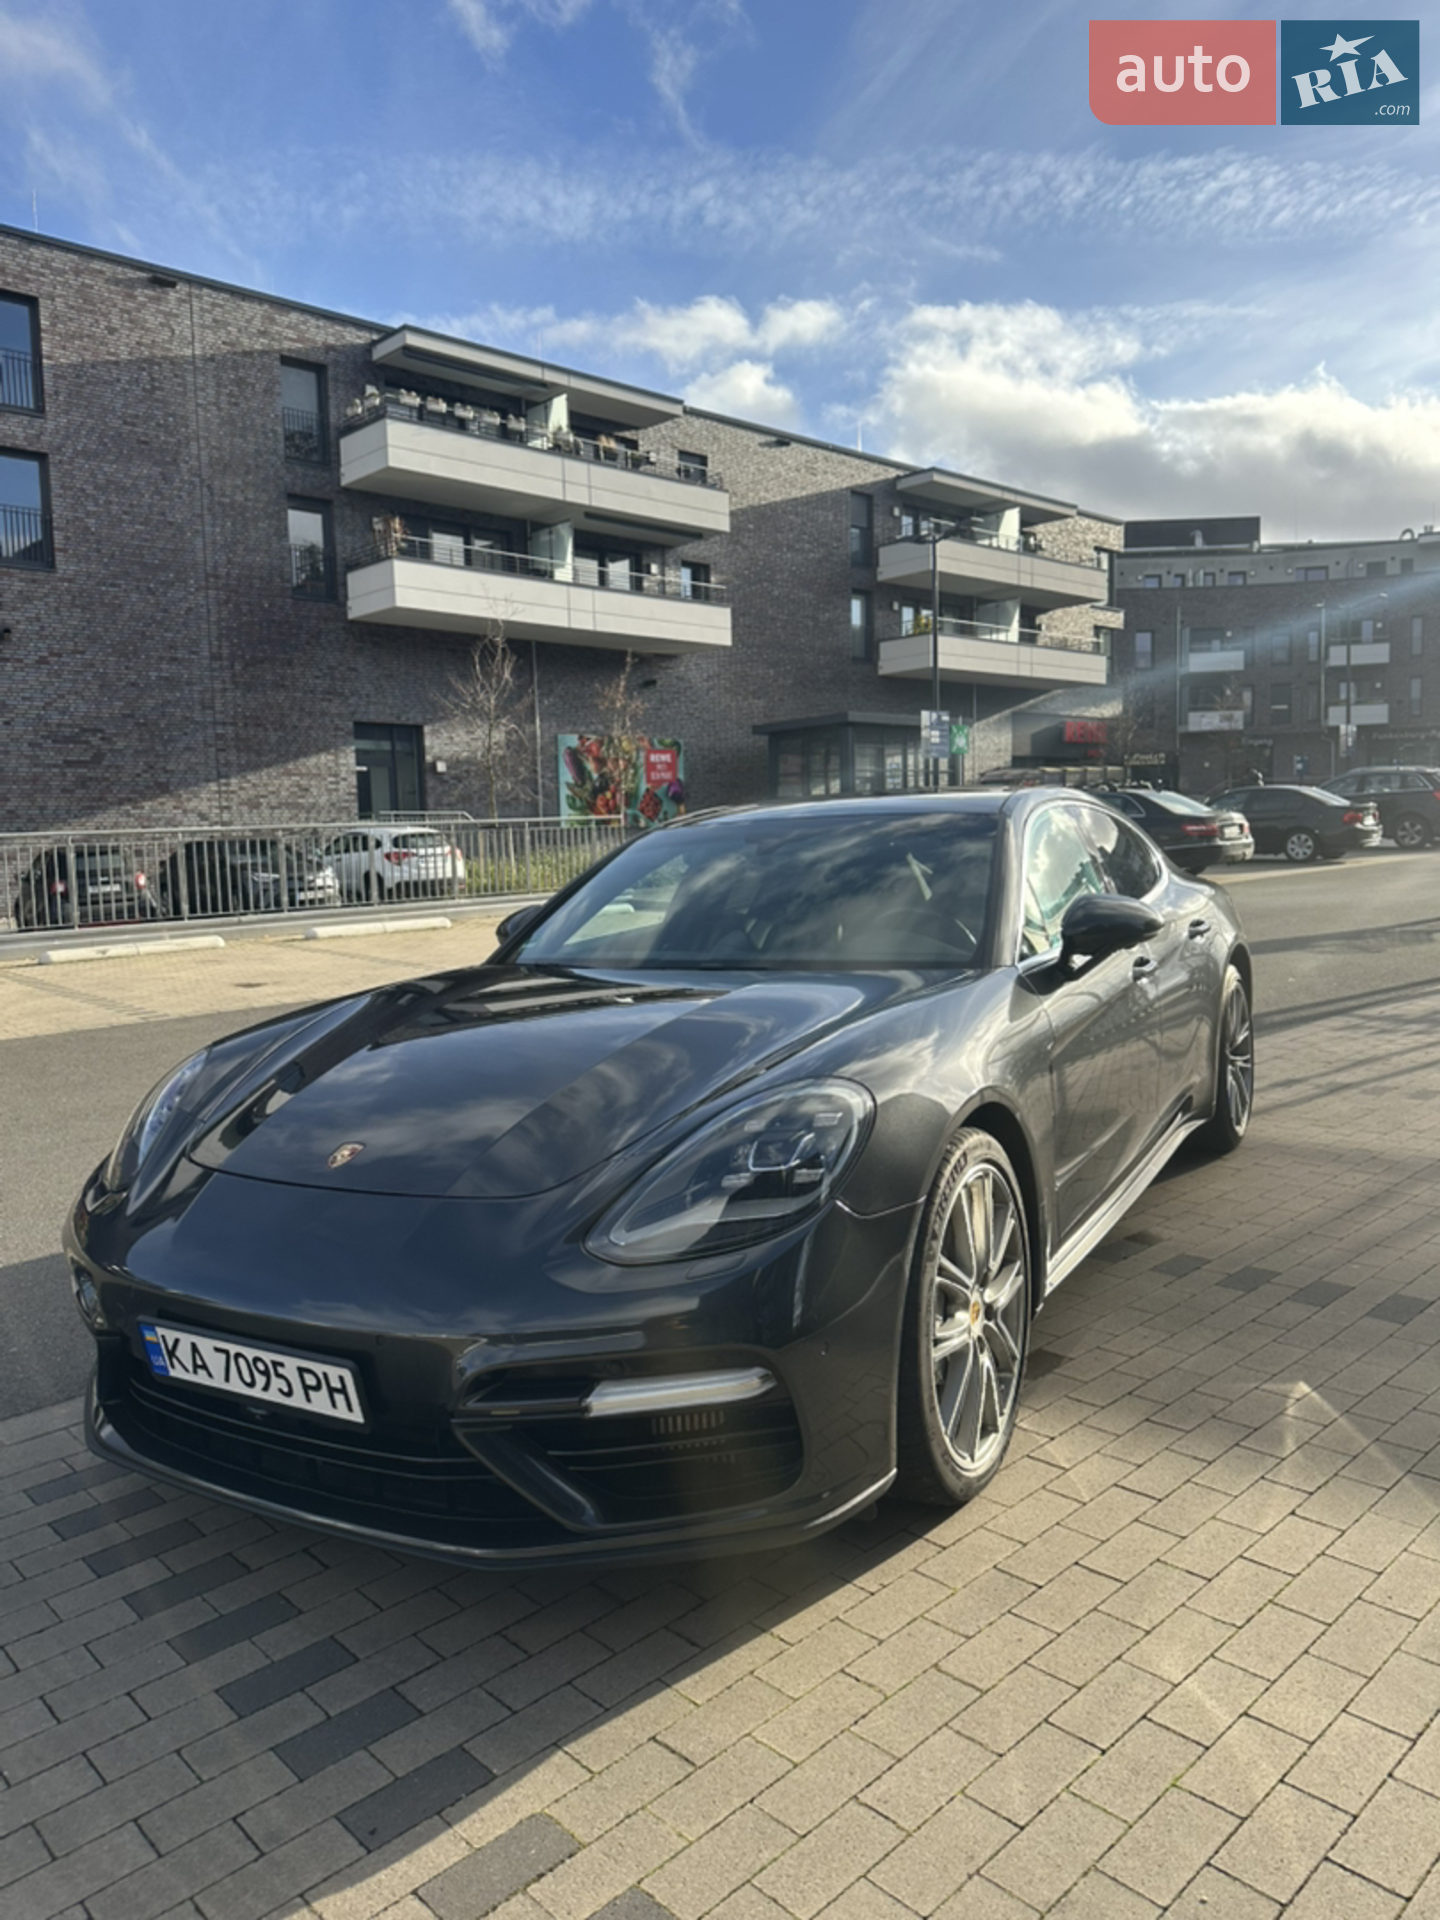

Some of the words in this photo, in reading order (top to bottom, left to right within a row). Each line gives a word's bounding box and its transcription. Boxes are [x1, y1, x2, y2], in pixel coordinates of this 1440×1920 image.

[161, 1334, 214, 1379] KA
[213, 1346, 294, 1399] 7095
[297, 1365, 354, 1413] PH
